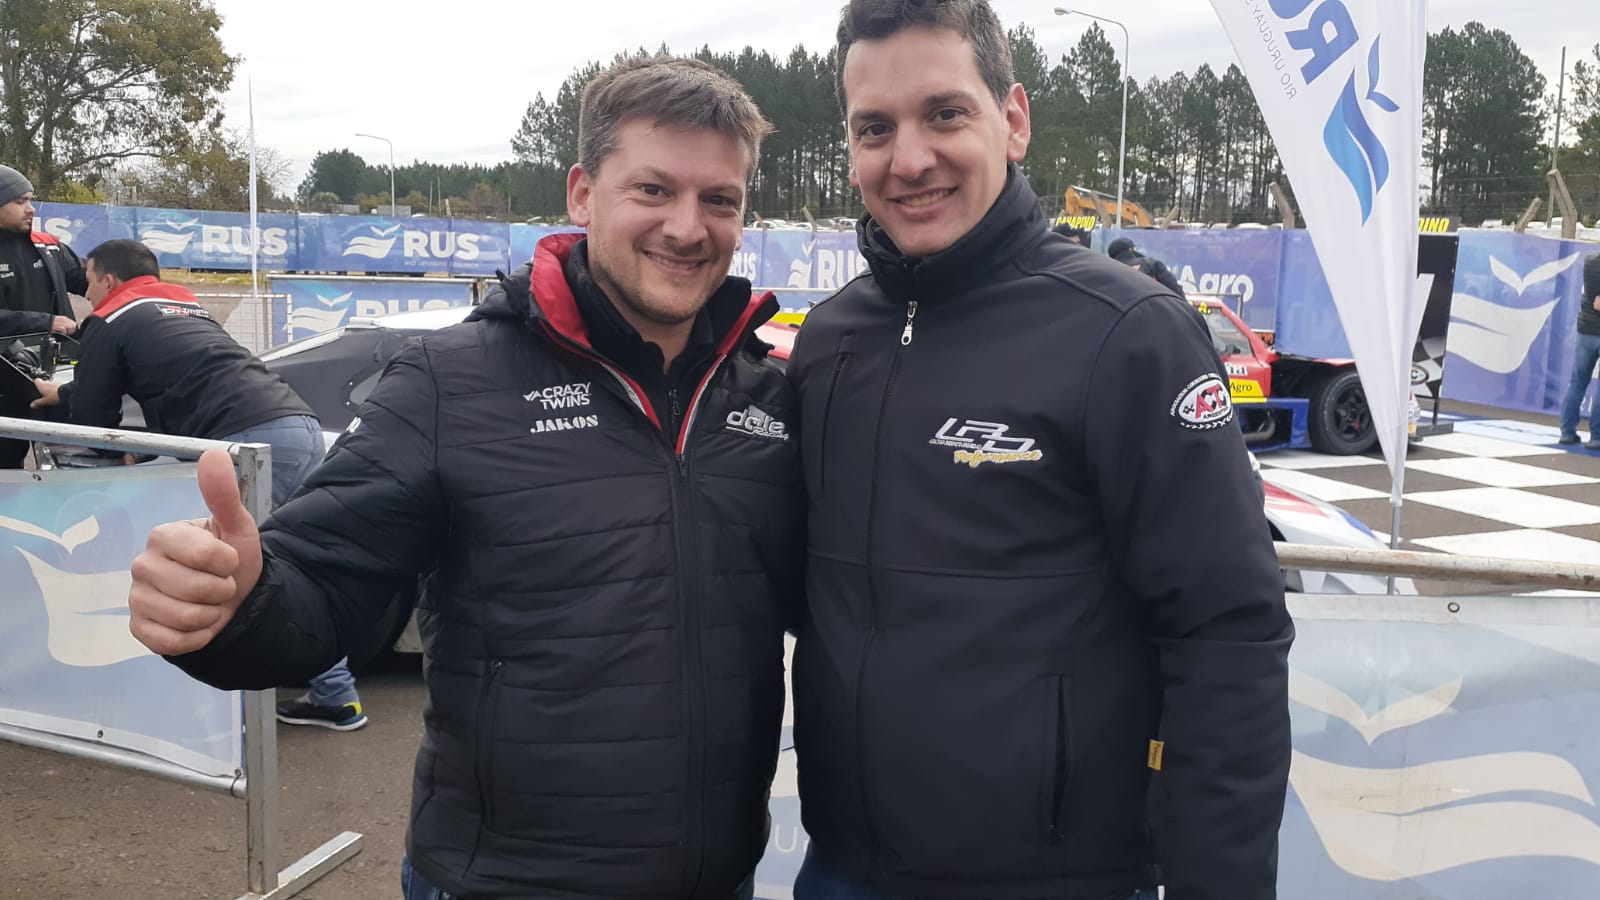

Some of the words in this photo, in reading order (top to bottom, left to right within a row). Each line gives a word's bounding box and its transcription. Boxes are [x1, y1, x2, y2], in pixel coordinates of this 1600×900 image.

[202, 225, 288, 256] RUS
[403, 230, 480, 260] RUS
[542, 382, 591, 400] CRAZY
[1230, 380, 1253, 393] Agro
[541, 393, 590, 410] TWINS
[530, 415, 598, 433] JAKOS
